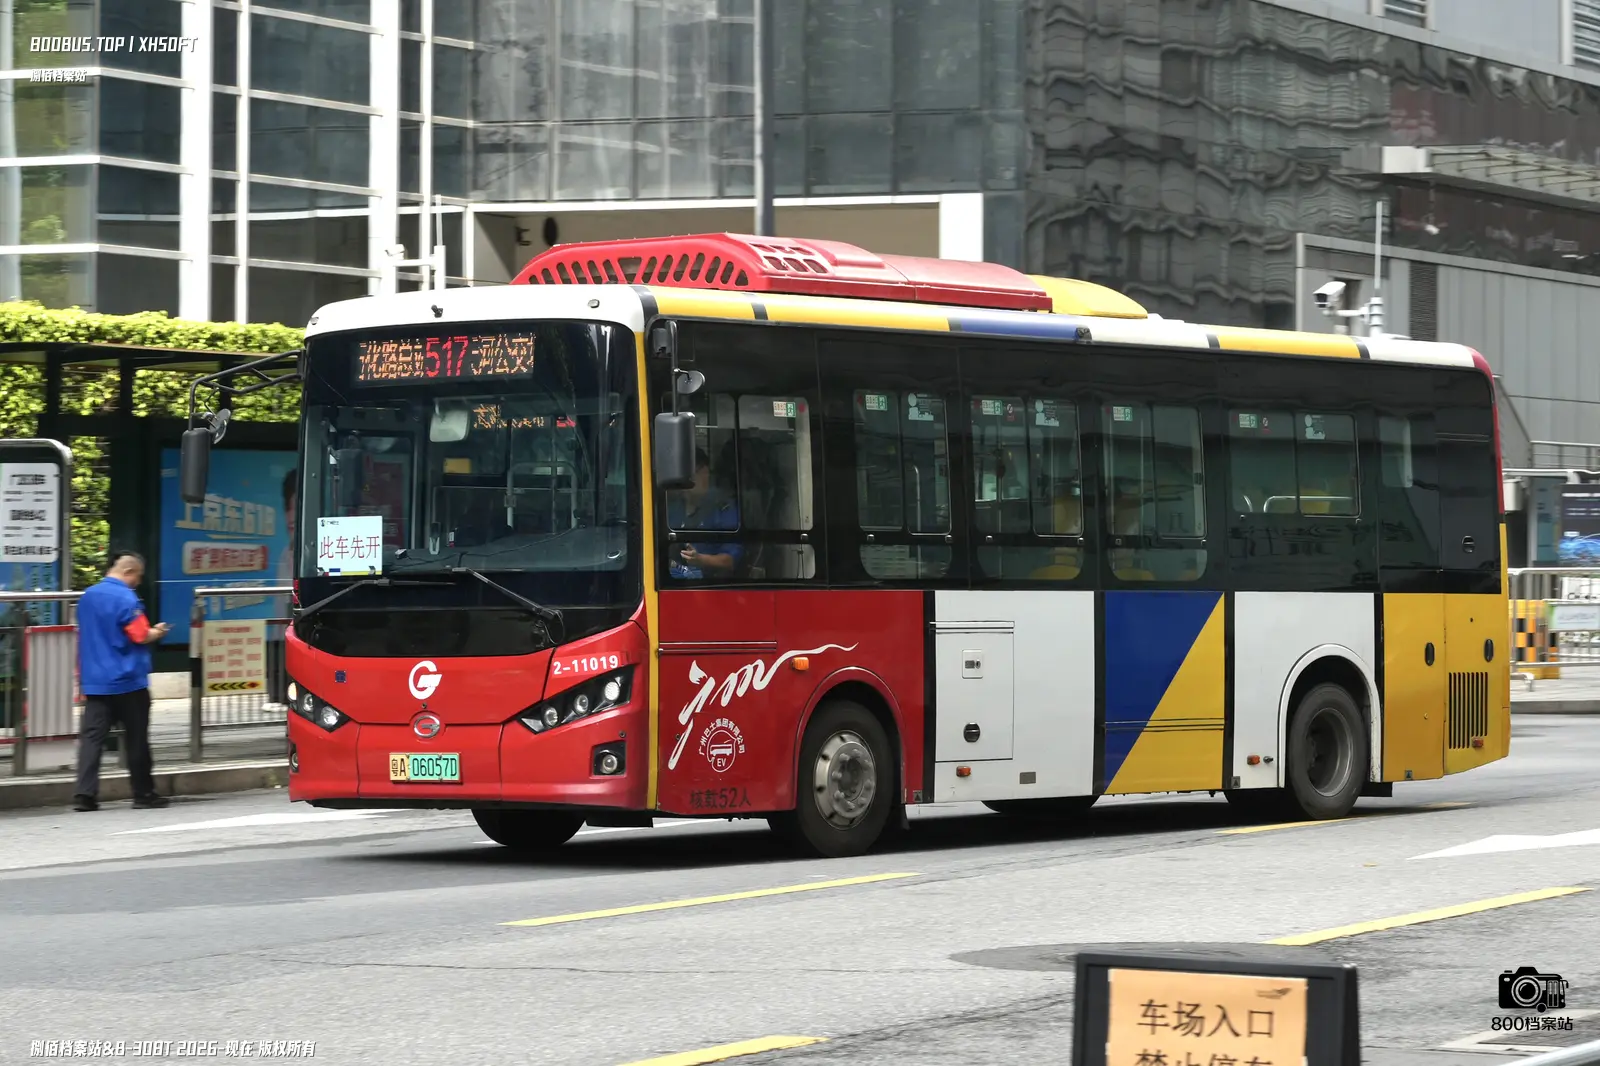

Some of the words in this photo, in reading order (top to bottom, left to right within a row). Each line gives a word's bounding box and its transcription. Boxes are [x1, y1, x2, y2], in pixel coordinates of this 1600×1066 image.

[425, 335, 469, 377] 517
[319, 535, 380, 560] 此车先开
[553, 655, 619, 675] 2-11019
[716, 758, 727, 767] EV
[1136, 998, 1275, 1038] 车场入口
